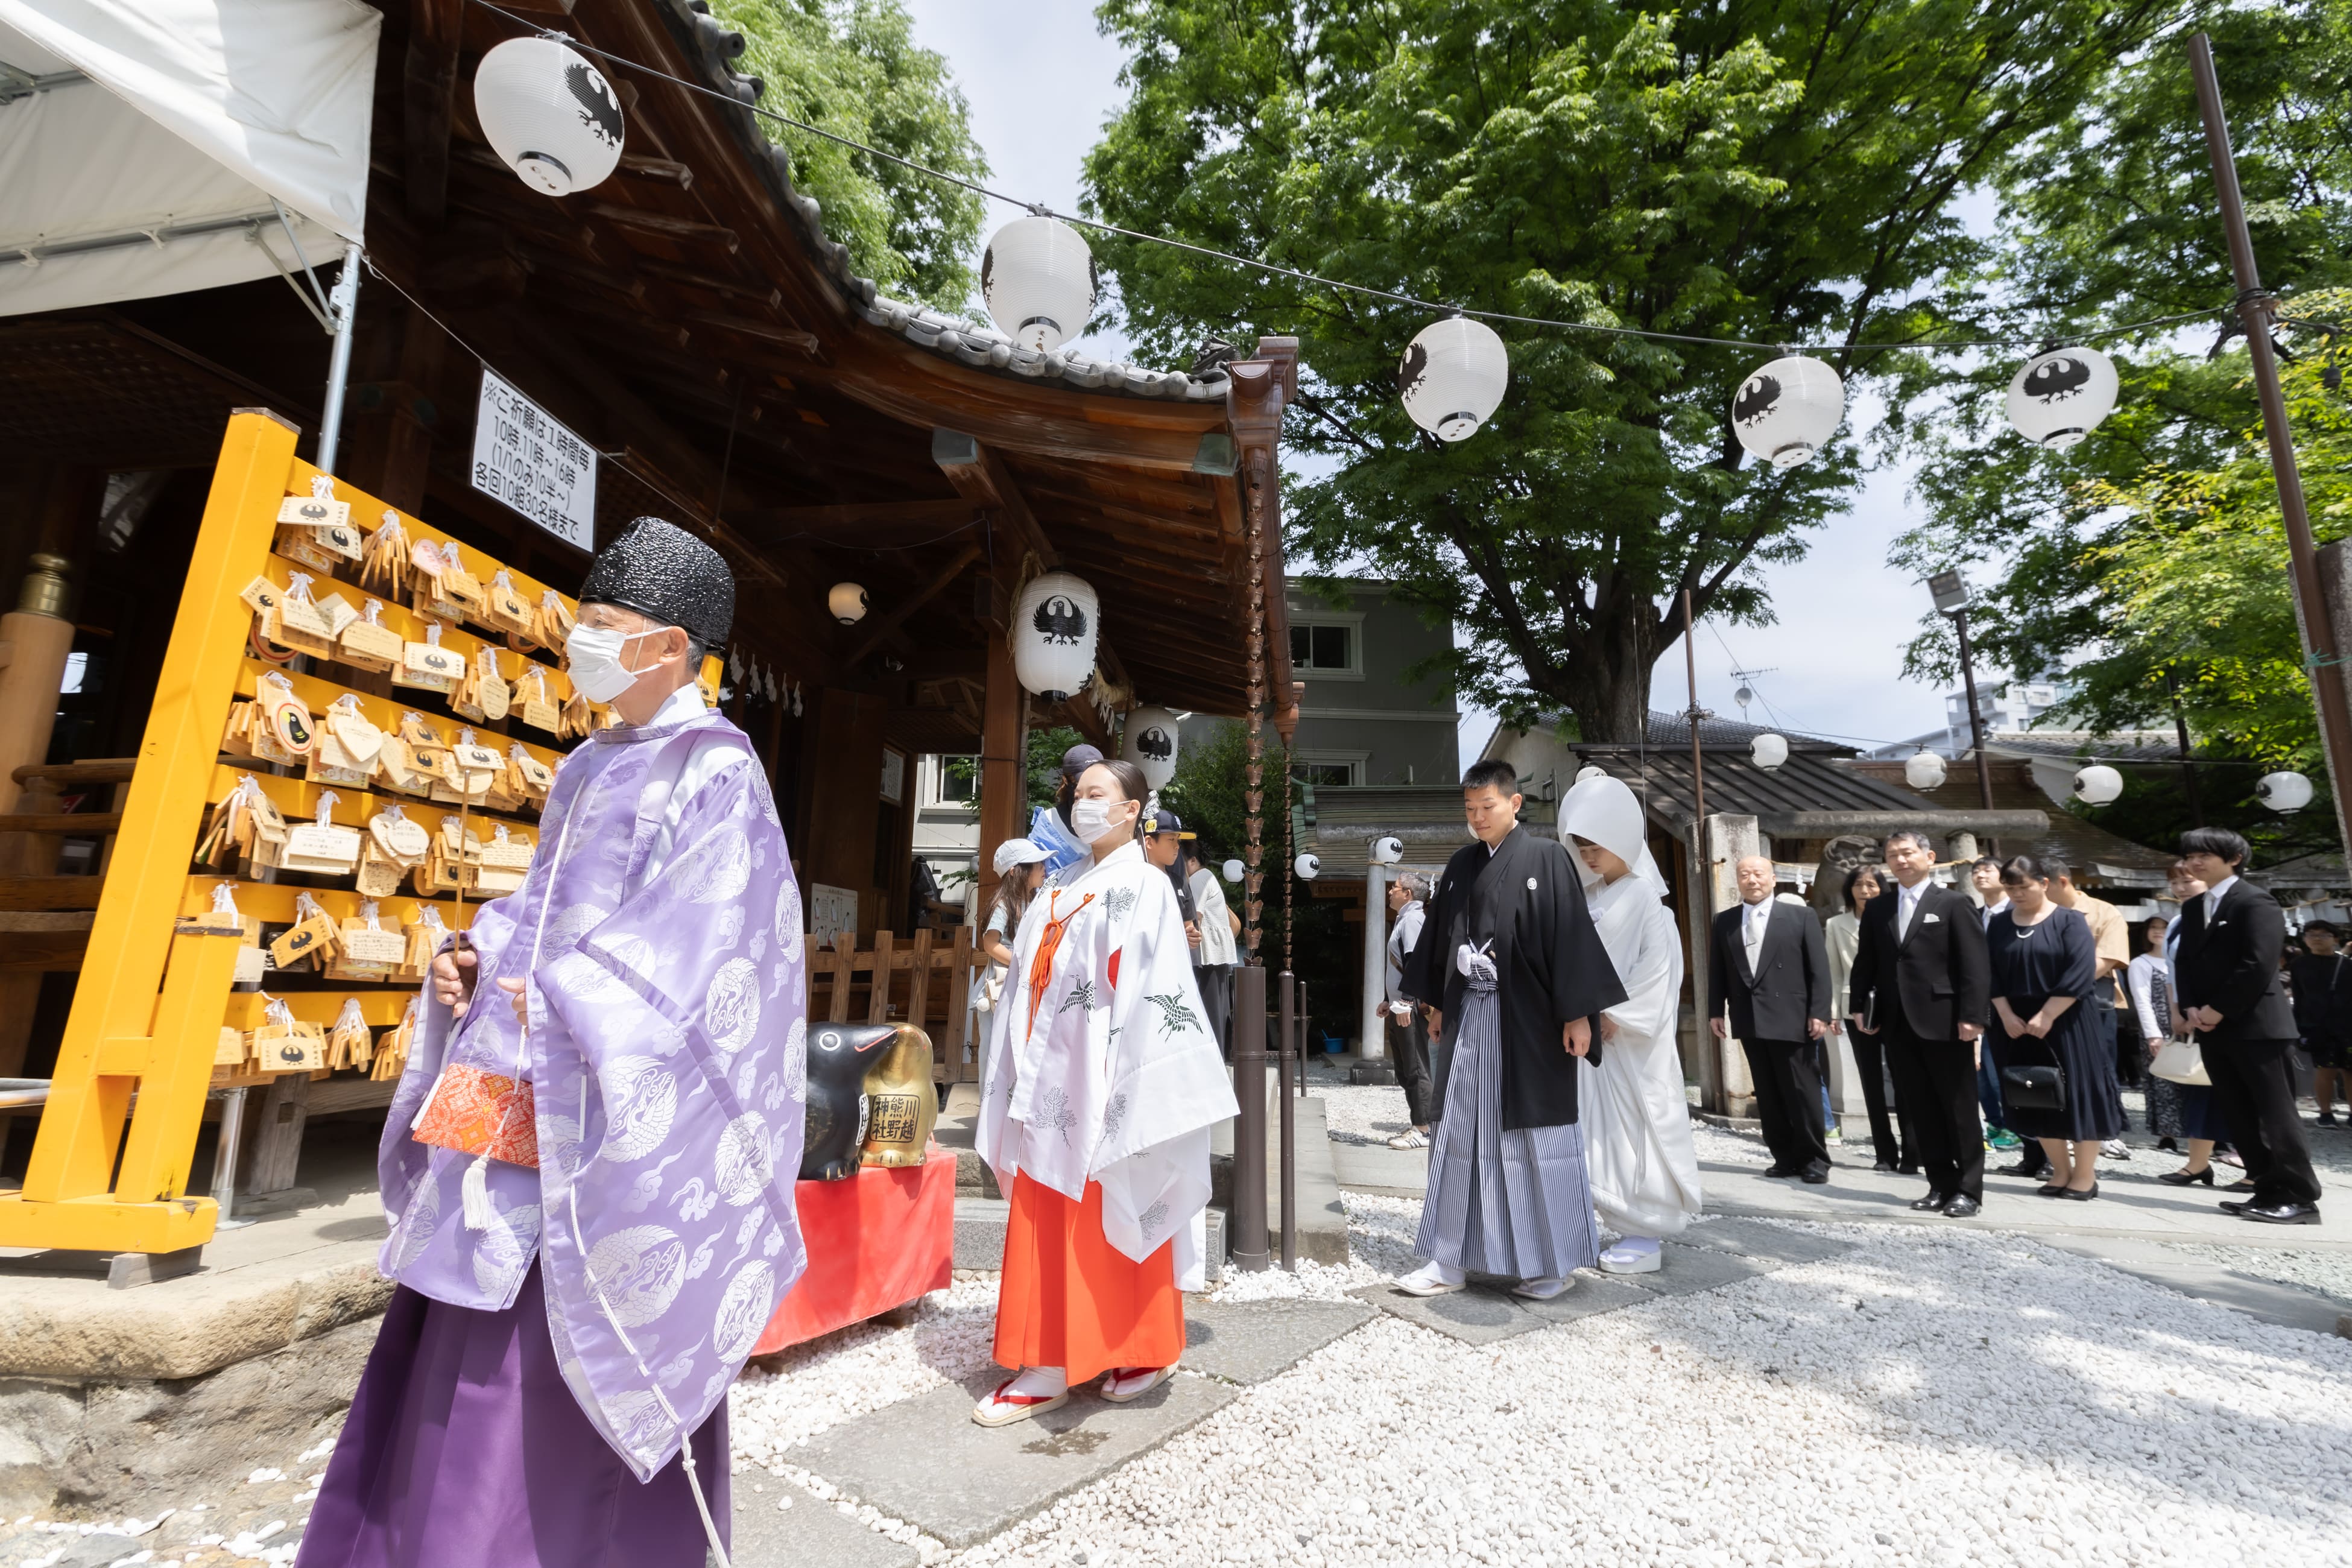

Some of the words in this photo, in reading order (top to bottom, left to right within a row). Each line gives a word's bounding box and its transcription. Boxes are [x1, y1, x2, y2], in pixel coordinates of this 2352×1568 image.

[475, 461, 578, 540] 各回10組30名様まで
[872, 1096, 889, 1140] 神社
[886, 1096, 905, 1139] 熊野
[899, 1099, 917, 1140] 川越
